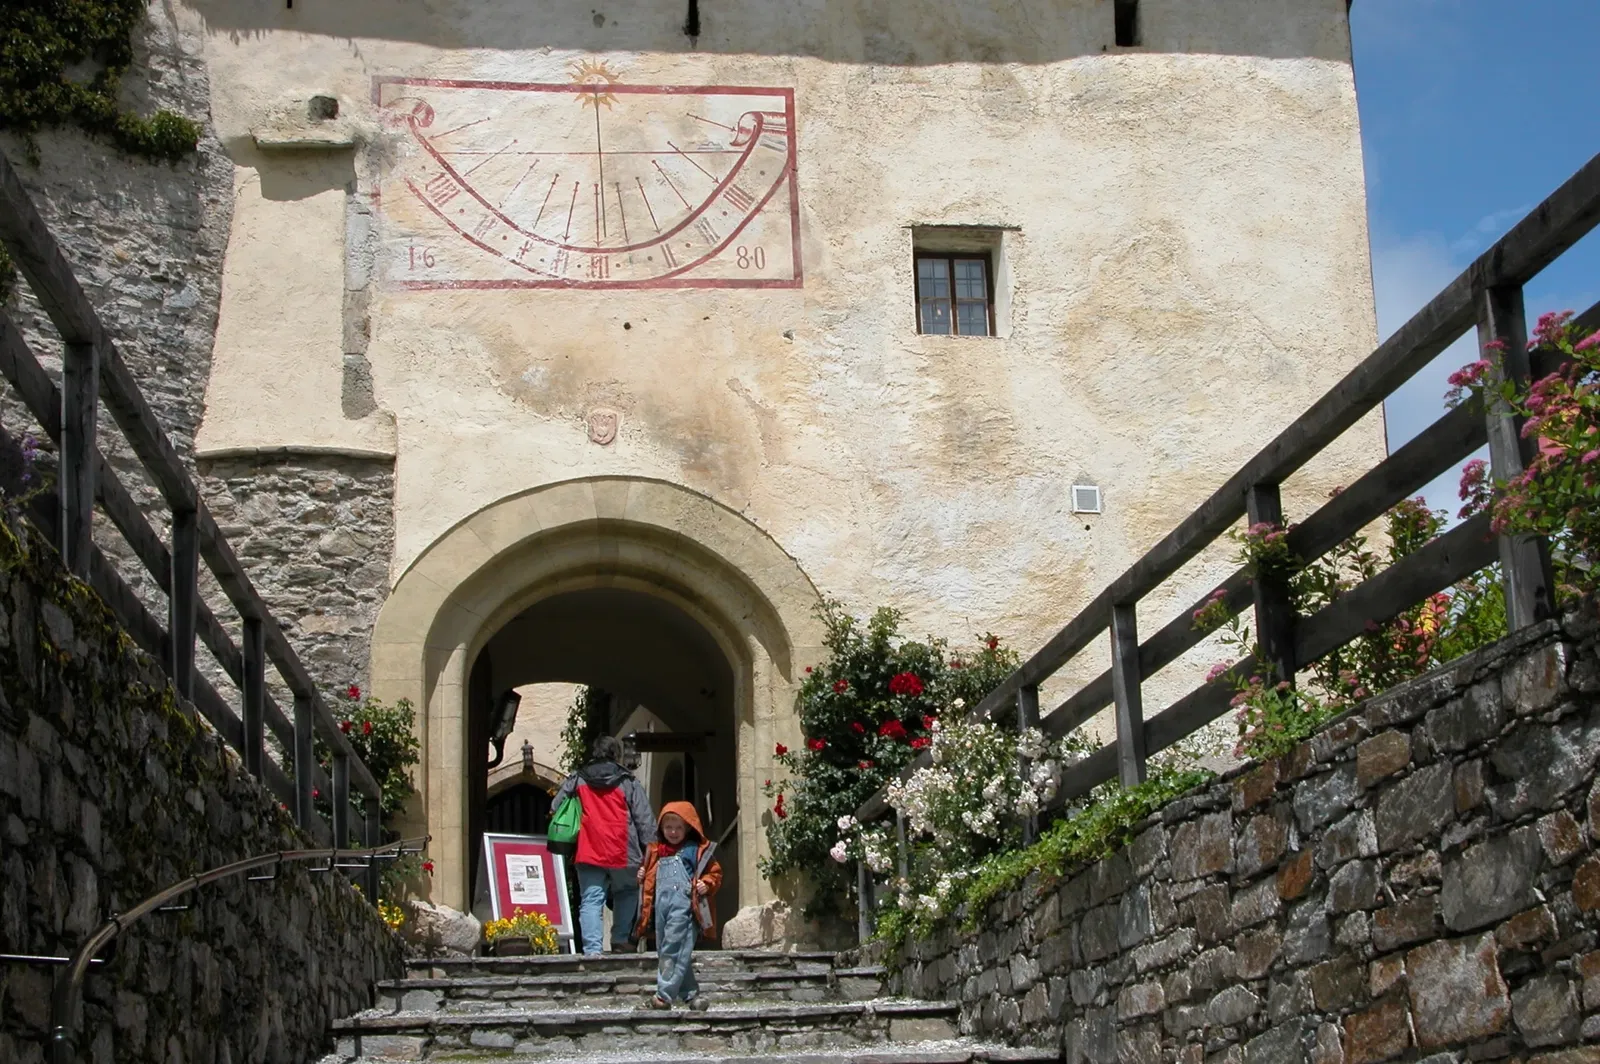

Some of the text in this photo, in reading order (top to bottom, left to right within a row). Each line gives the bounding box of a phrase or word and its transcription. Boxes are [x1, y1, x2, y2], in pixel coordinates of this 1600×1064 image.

[660, 243, 678, 268] II
[694, 216, 720, 245] III
[723, 183, 755, 212] IIII
